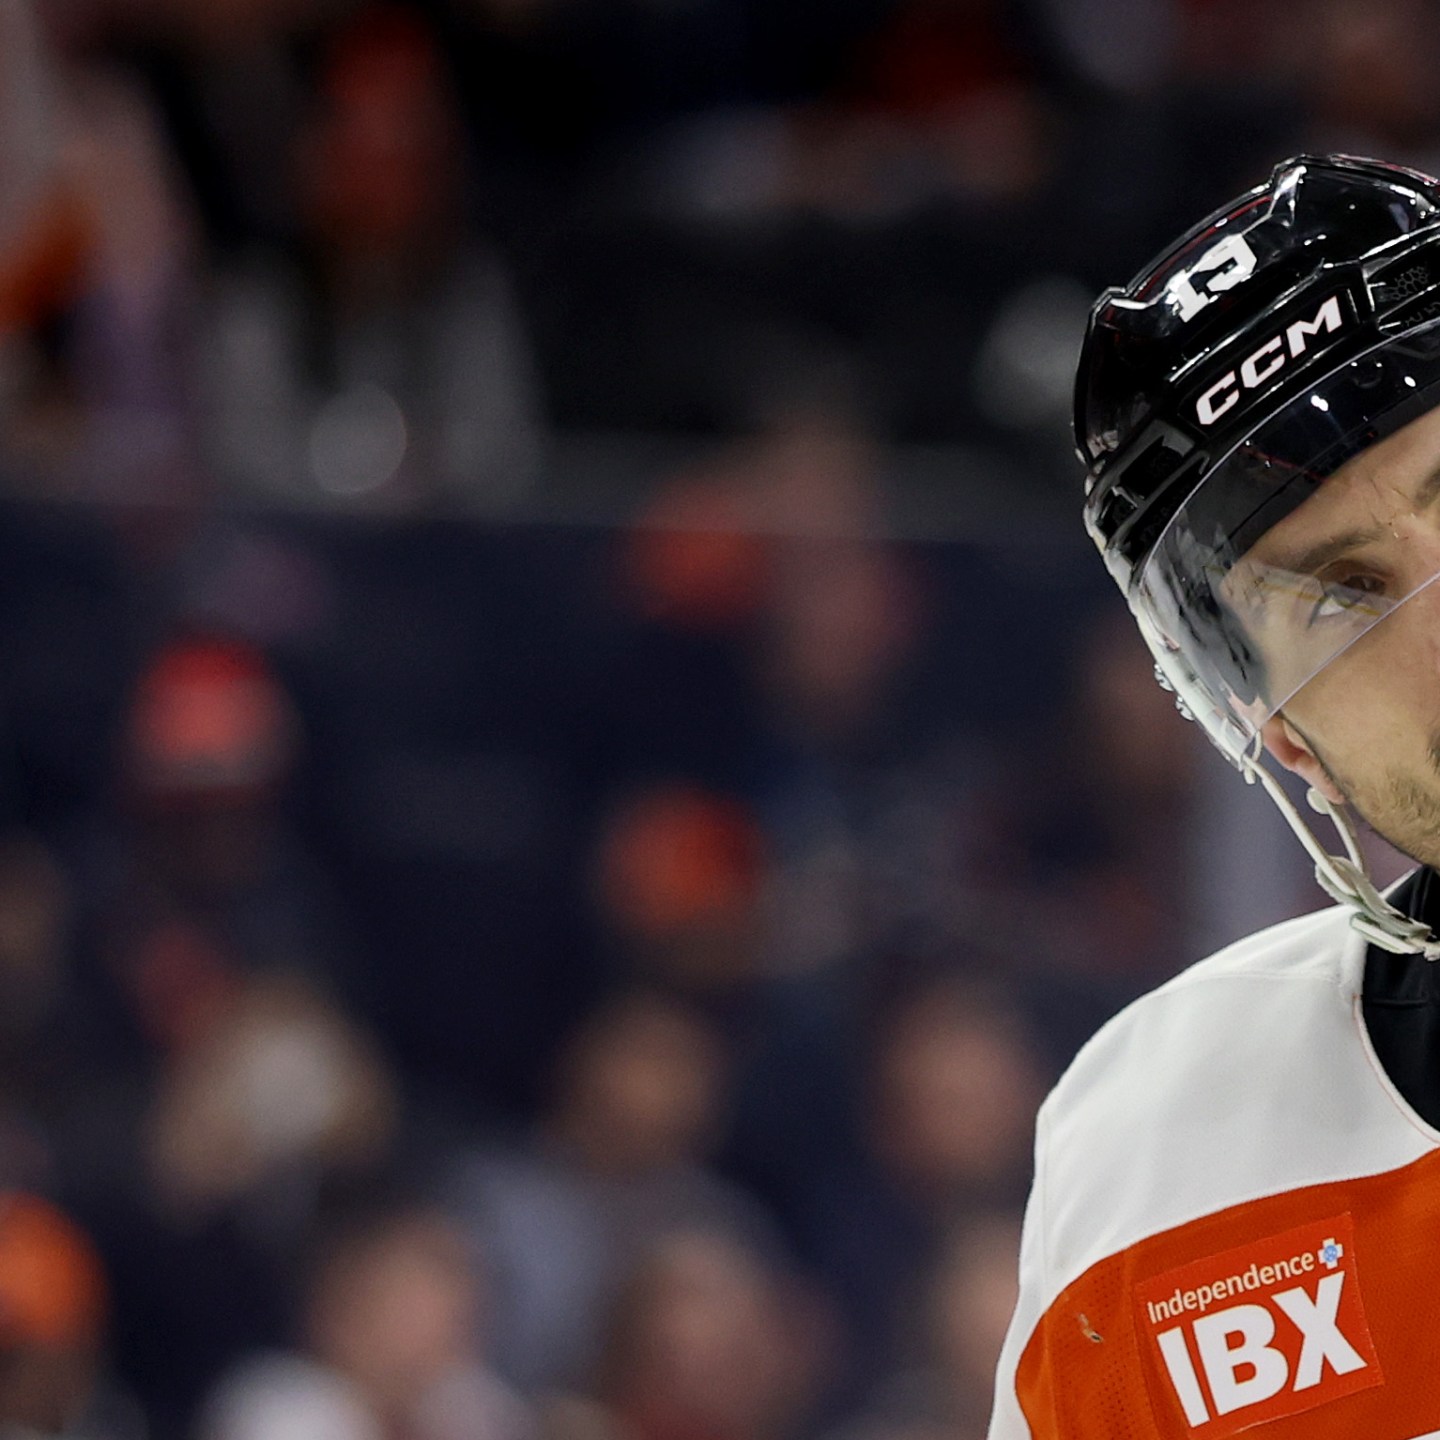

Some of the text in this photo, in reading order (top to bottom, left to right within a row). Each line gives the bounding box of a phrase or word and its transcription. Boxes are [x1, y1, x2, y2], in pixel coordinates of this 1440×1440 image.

[1196, 295, 1343, 425] CCM
[1147, 1252, 1315, 1324] Independence
[1157, 1271, 1368, 1428] IBX
